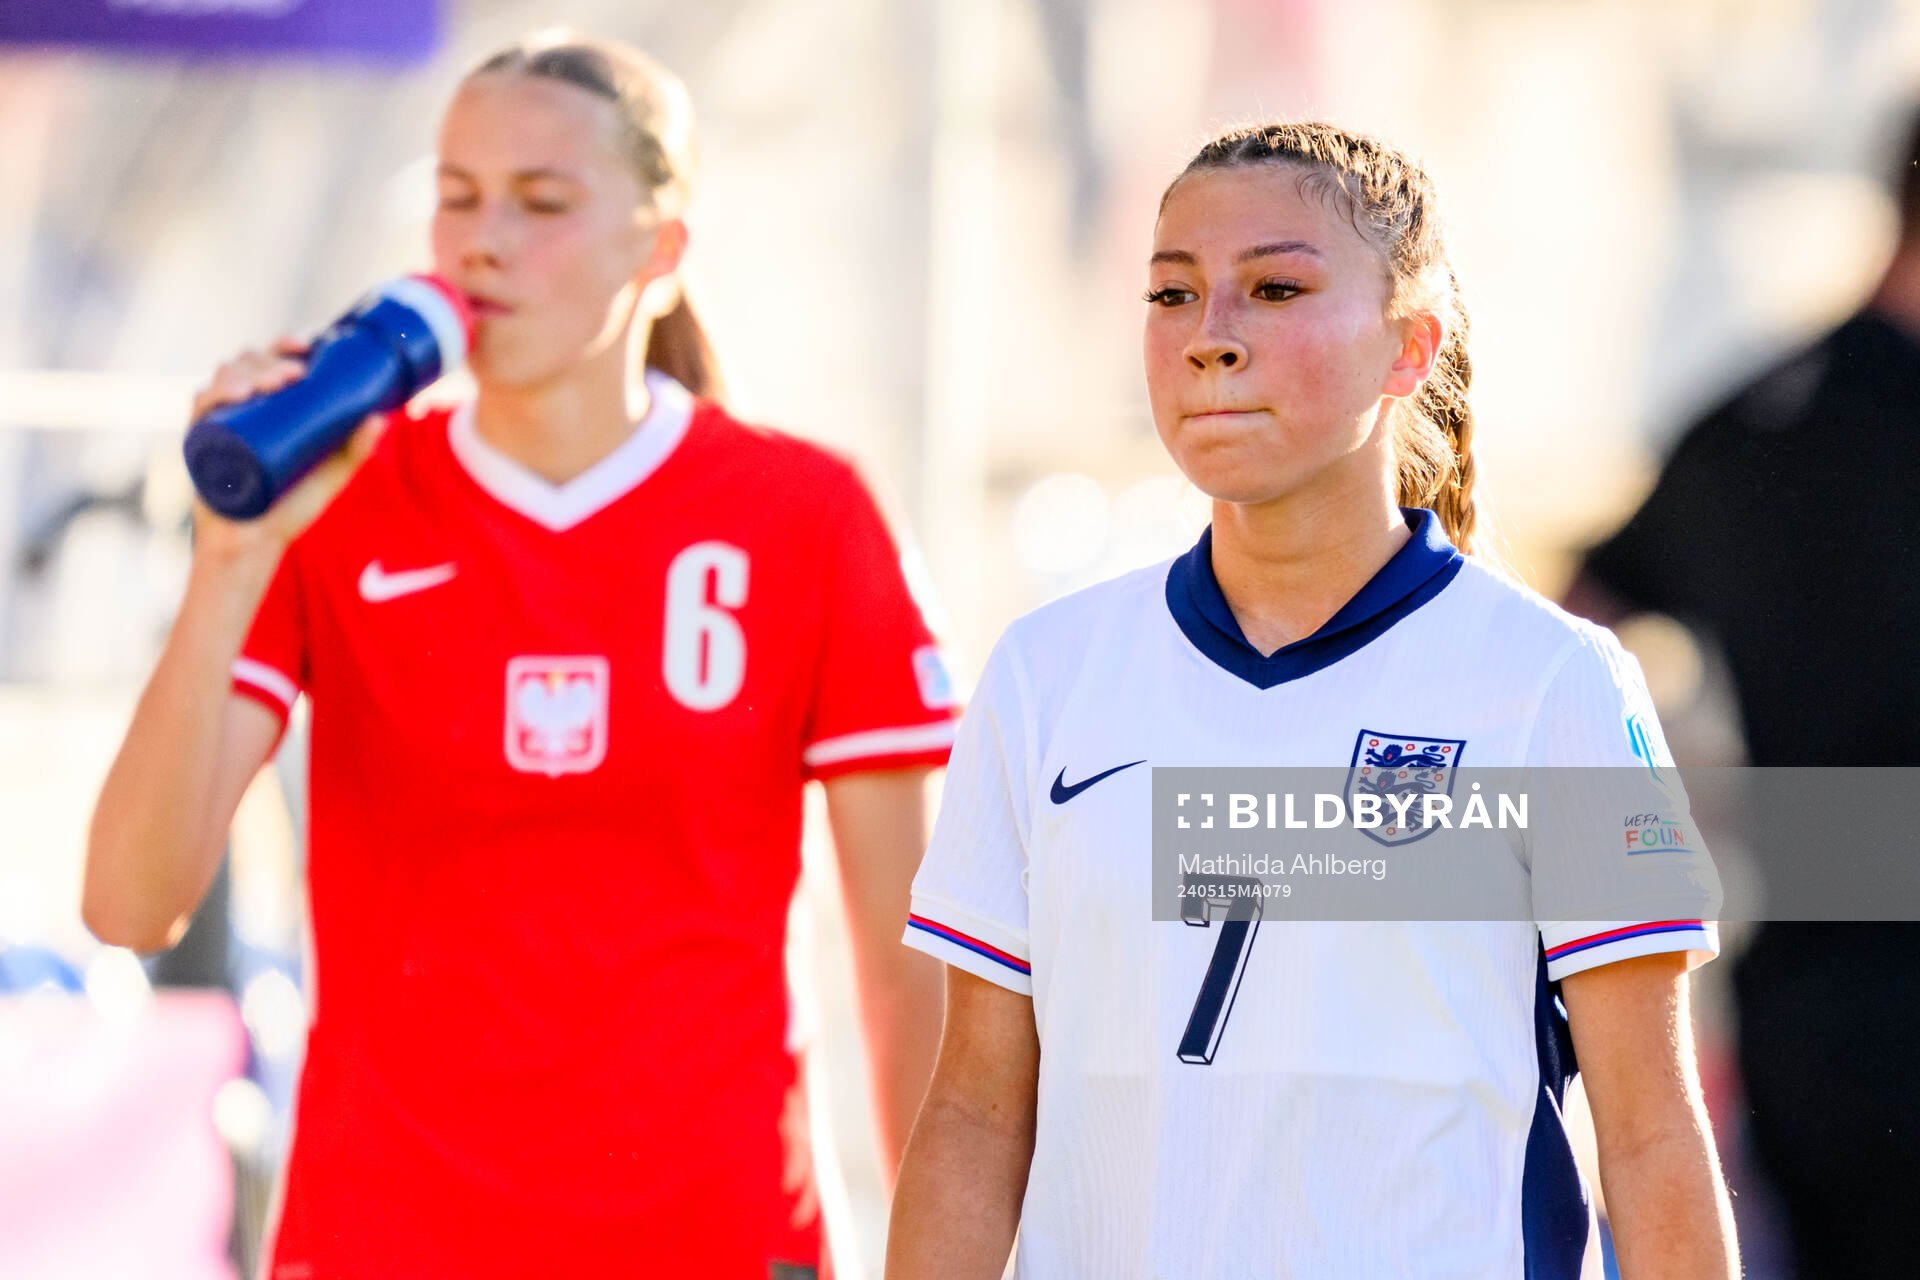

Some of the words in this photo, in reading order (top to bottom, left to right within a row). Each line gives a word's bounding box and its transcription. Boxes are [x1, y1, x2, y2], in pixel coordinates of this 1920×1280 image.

[662, 540, 750, 713] 6
[1624, 813, 1660, 827] UEFA
[1176, 871, 1264, 1065] 7
